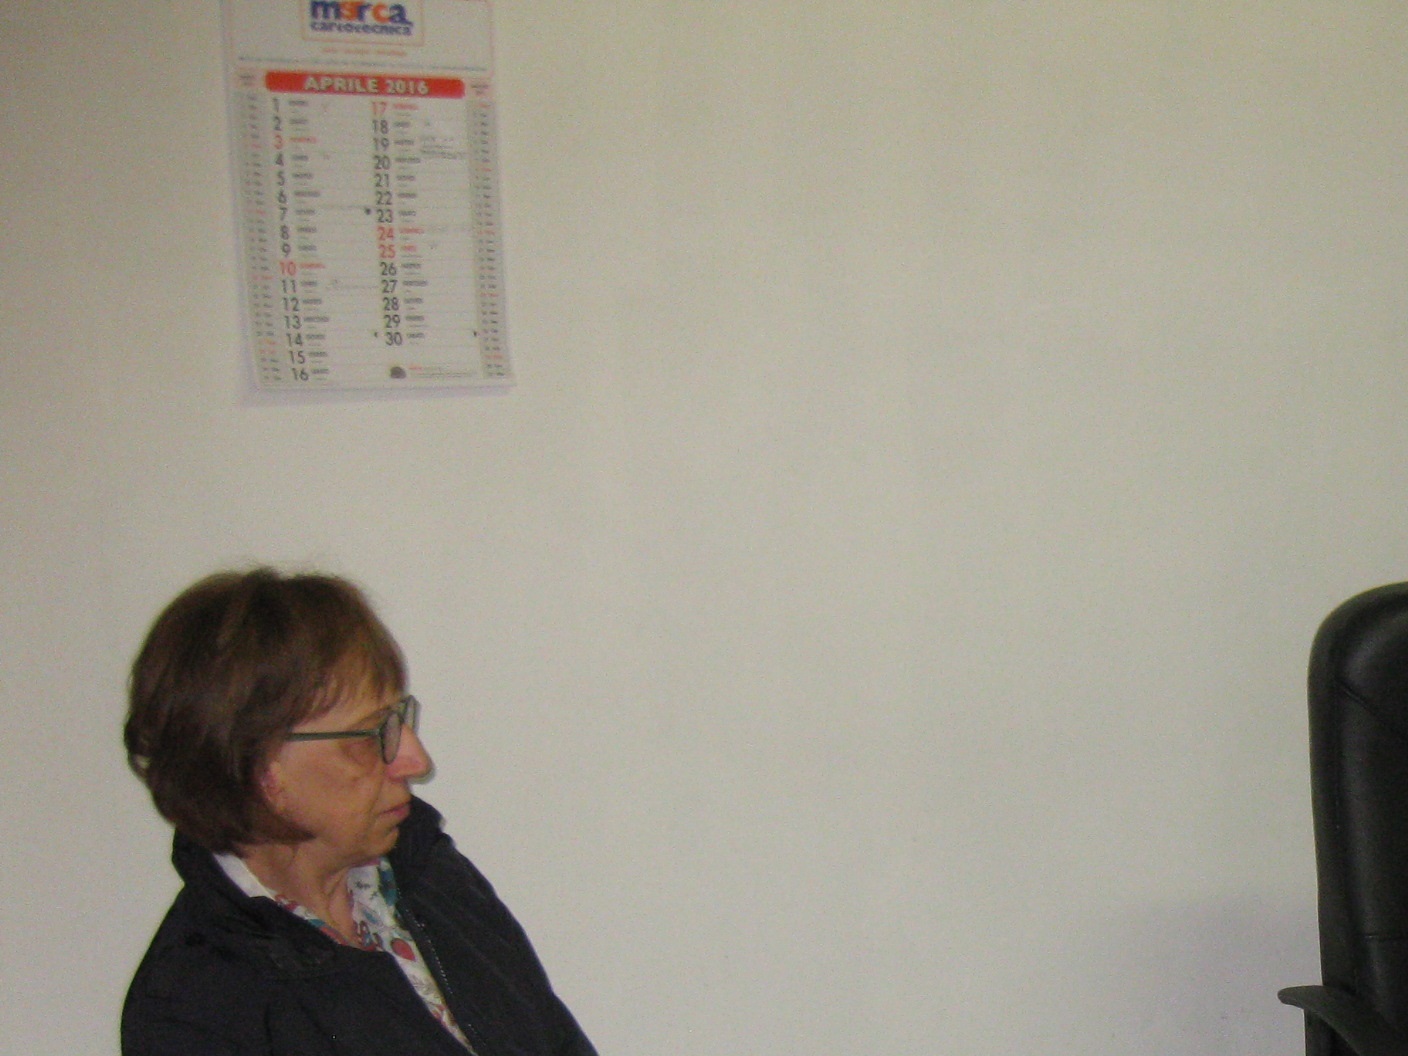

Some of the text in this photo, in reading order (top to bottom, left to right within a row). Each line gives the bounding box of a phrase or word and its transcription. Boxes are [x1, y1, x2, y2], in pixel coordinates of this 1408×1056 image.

[304, 76, 429, 95] APRILE 2016
[371, 101, 388, 116] 17
[273, 116, 282, 131] 2
[372, 119, 389, 134] 18
[274, 134, 283, 149] 3
[372, 137, 390, 151] 19
[275, 153, 284, 166] 4
[373, 155, 391, 170] 20
[277, 171, 285, 186] 5
[374, 173, 390, 188] 21
[278, 189, 287, 204] 6
[375, 191, 393, 205] 22
[279, 207, 288, 221] 7
[376, 208, 393, 223] 23
[280, 225, 289, 240] 8
[377, 226, 394, 241] 24
[282, 243, 291, 257] 9
[378, 244, 396, 259] 25
[279, 261, 297, 276] 10
[379, 261, 397, 276] 26
[281, 279, 297, 293] 11
[381, 279, 398, 294] 27
[282, 297, 300, 312] 12
[382, 297, 400, 311] 28
[284, 315, 302, 329] 13
[383, 314, 401, 328] 29
[286, 333, 303, 347] 14
[384, 331, 403, 346] 30
[289, 350, 305, 364] 15
[291, 368, 309, 381] 16
